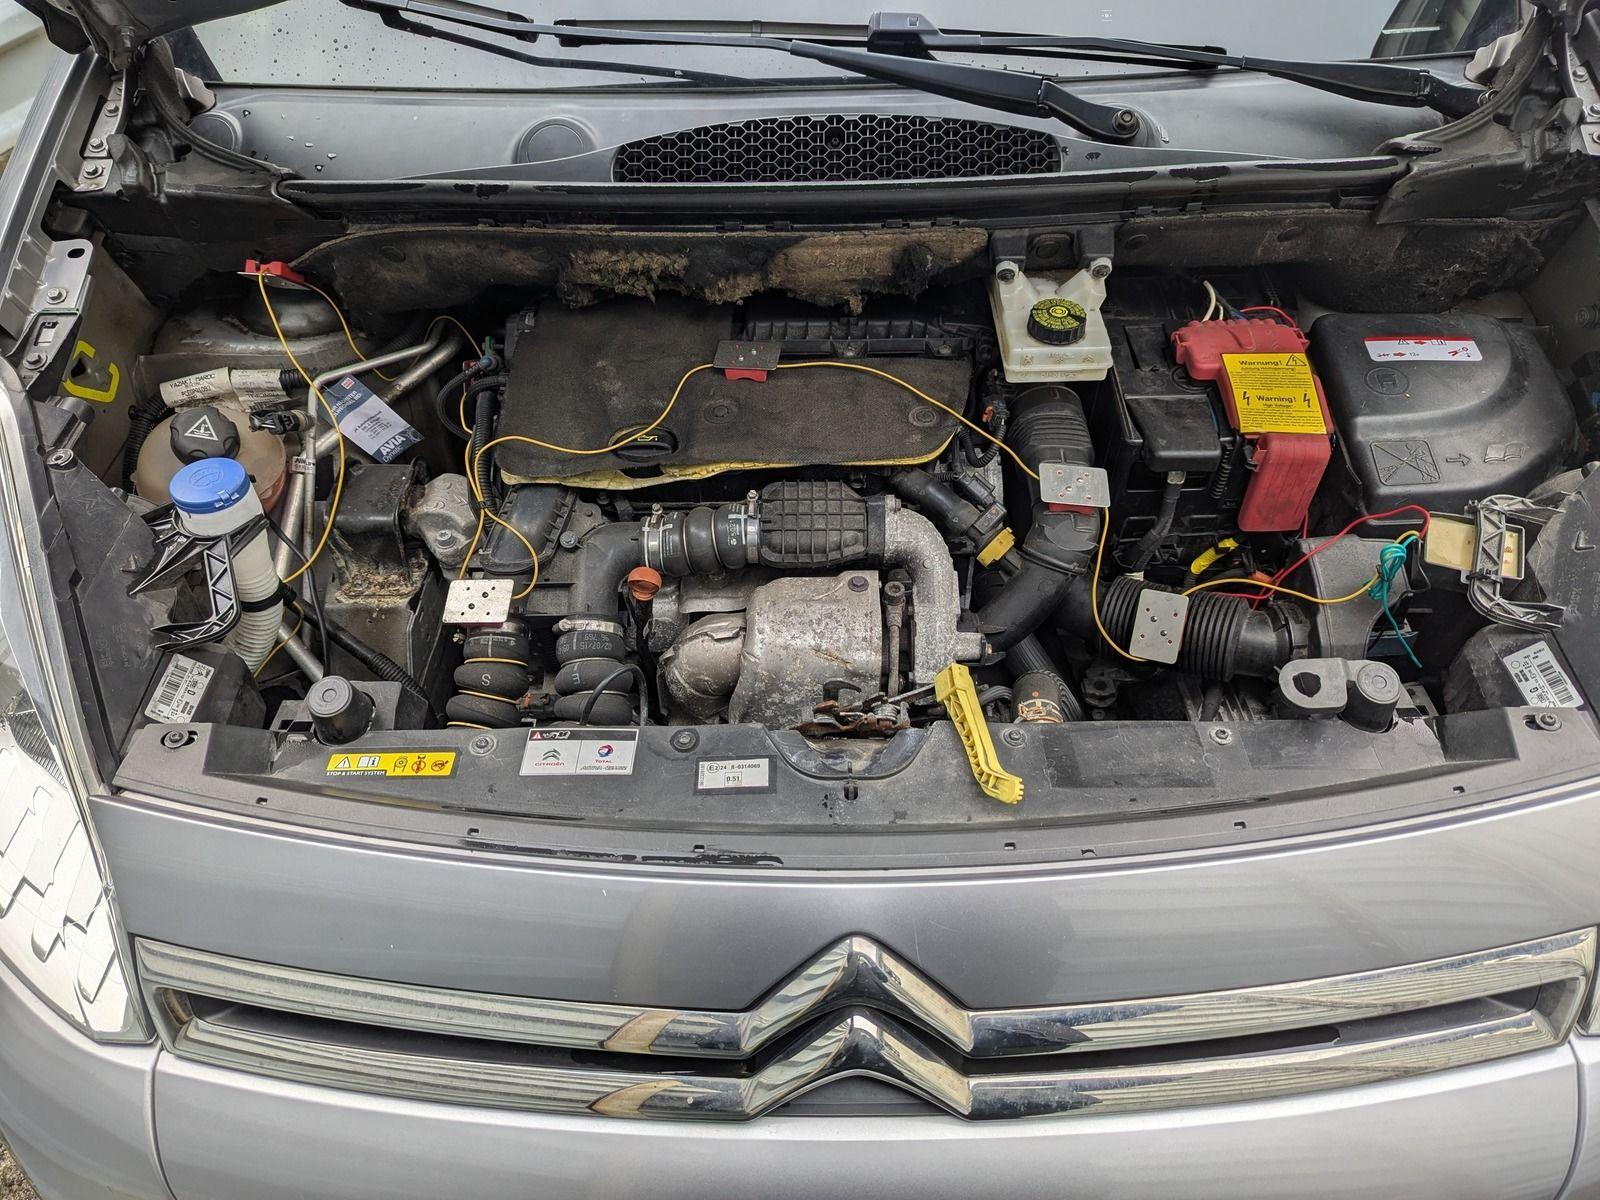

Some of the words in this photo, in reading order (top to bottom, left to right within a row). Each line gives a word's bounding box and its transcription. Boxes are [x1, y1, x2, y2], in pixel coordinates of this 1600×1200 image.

[1256, 395, 1296, 403] Warning!
[380, 434, 406, 456] AVIA
[481, 673, 492, 687] S
